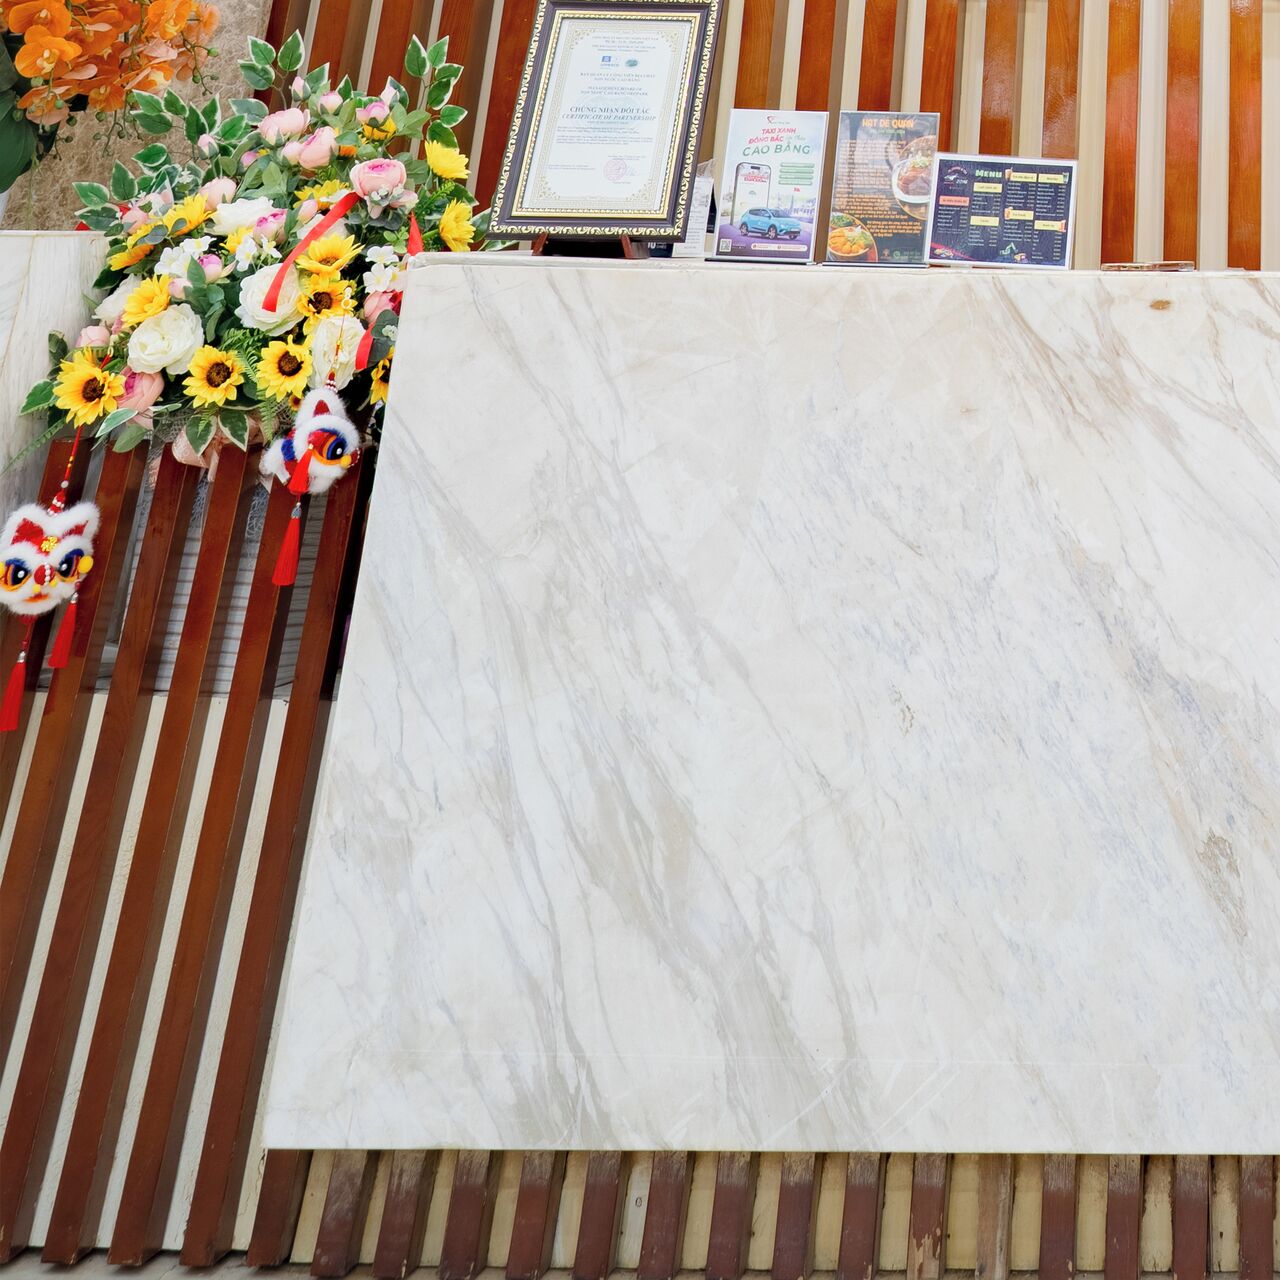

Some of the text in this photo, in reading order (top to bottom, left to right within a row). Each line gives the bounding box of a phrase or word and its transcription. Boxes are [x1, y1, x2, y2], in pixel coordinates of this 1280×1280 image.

[761, 127, 776, 135] TAXI
[742, 145, 770, 157] CAO
[975, 169, 1002, 178] MENU
